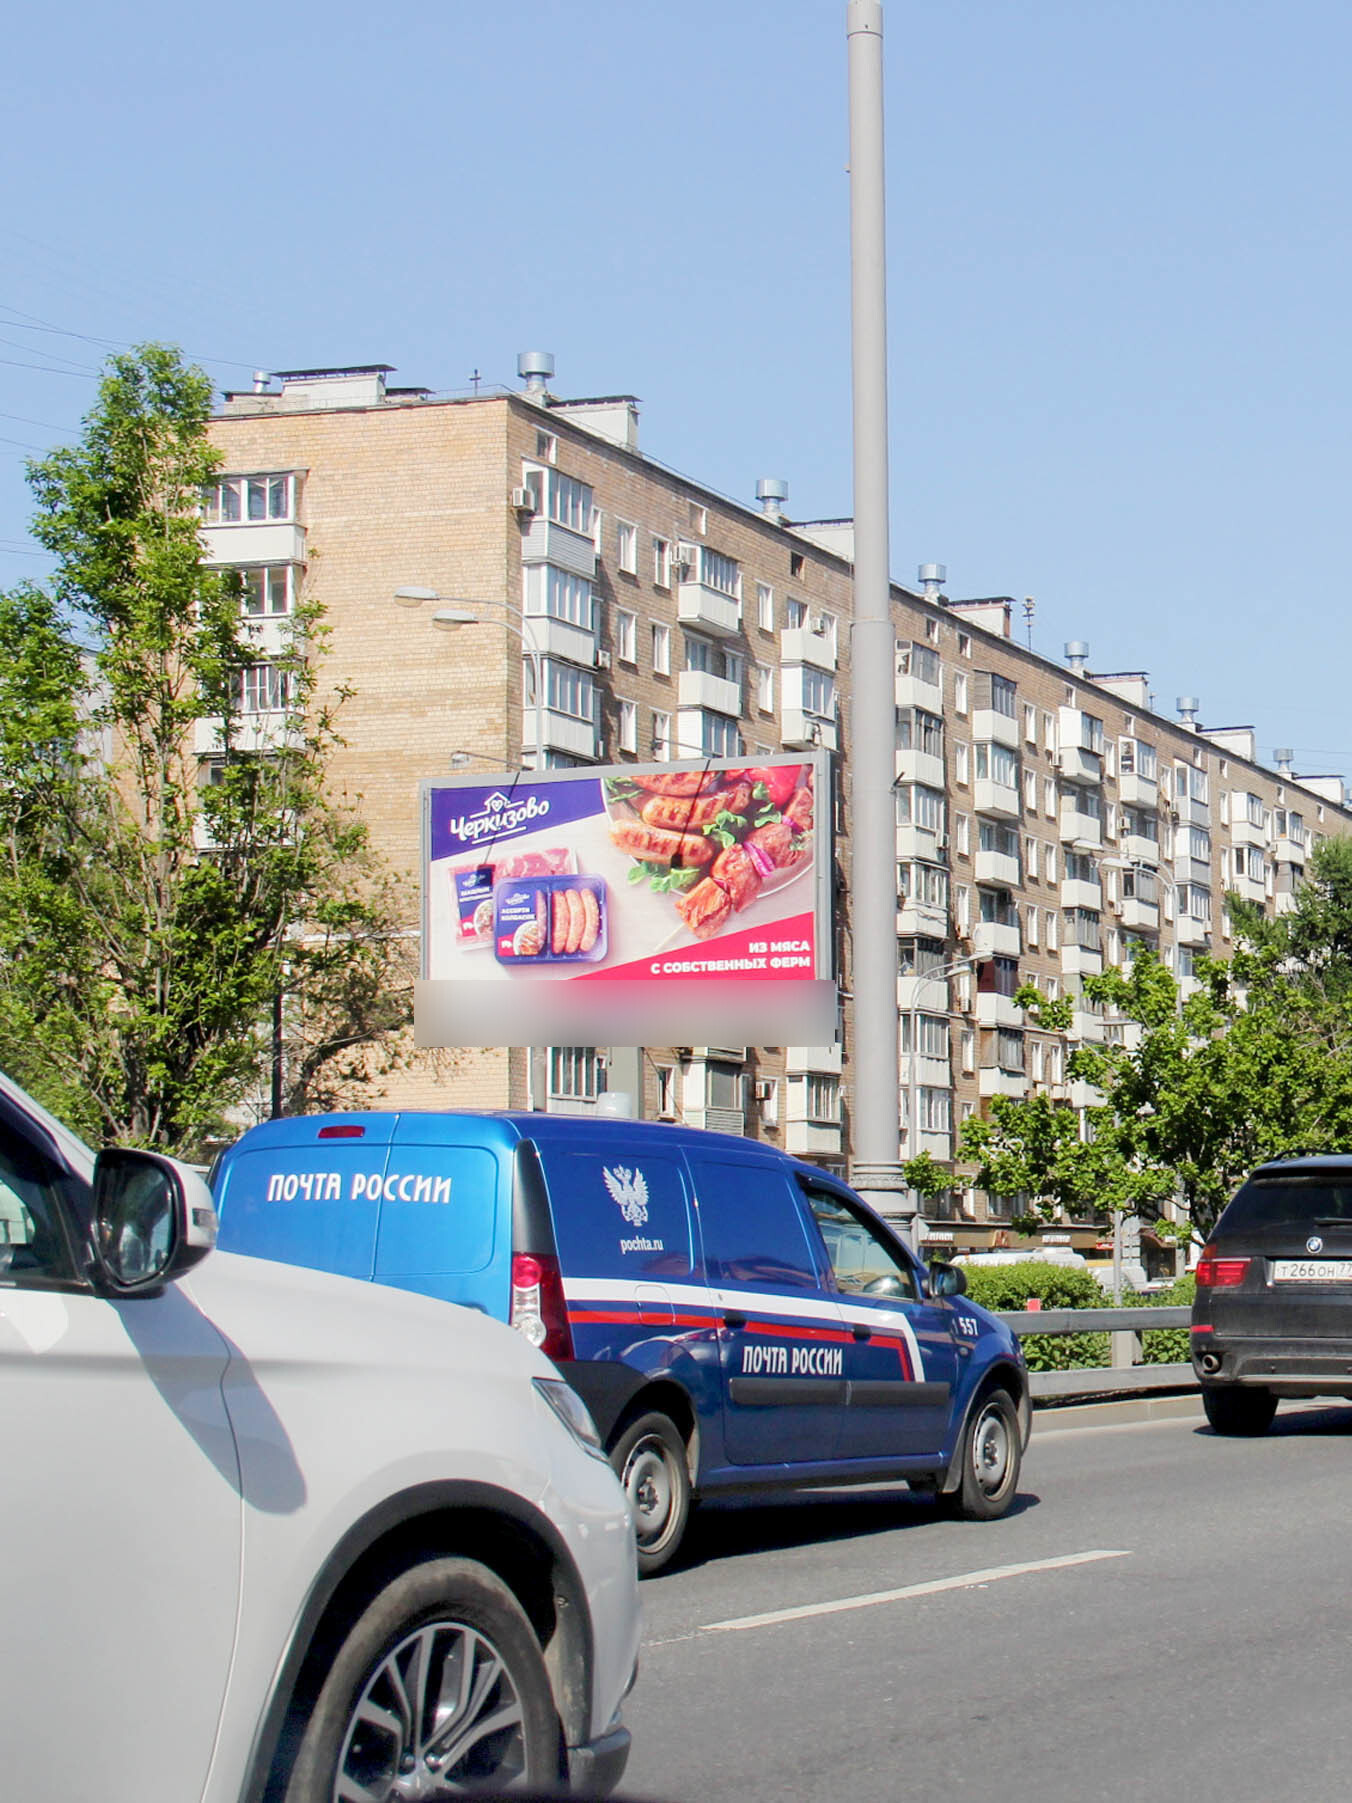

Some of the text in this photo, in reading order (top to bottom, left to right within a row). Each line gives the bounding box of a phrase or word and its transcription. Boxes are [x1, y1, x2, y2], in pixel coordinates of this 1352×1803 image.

[450, 796, 550, 841] Черкизово
[748, 940, 811, 954] ИЗ МЯСА
[650, 956, 811, 974] С СОБСТВЕННЫХ ФЕРМ
[268, 1172, 452, 1204] ПОЧТА РОССИИ
[620, 1235, 664, 1255] pochta.ru
[958, 1316, 979, 1336] 557
[742, 1345, 843, 1376] ПОЧТА РОССИИ
